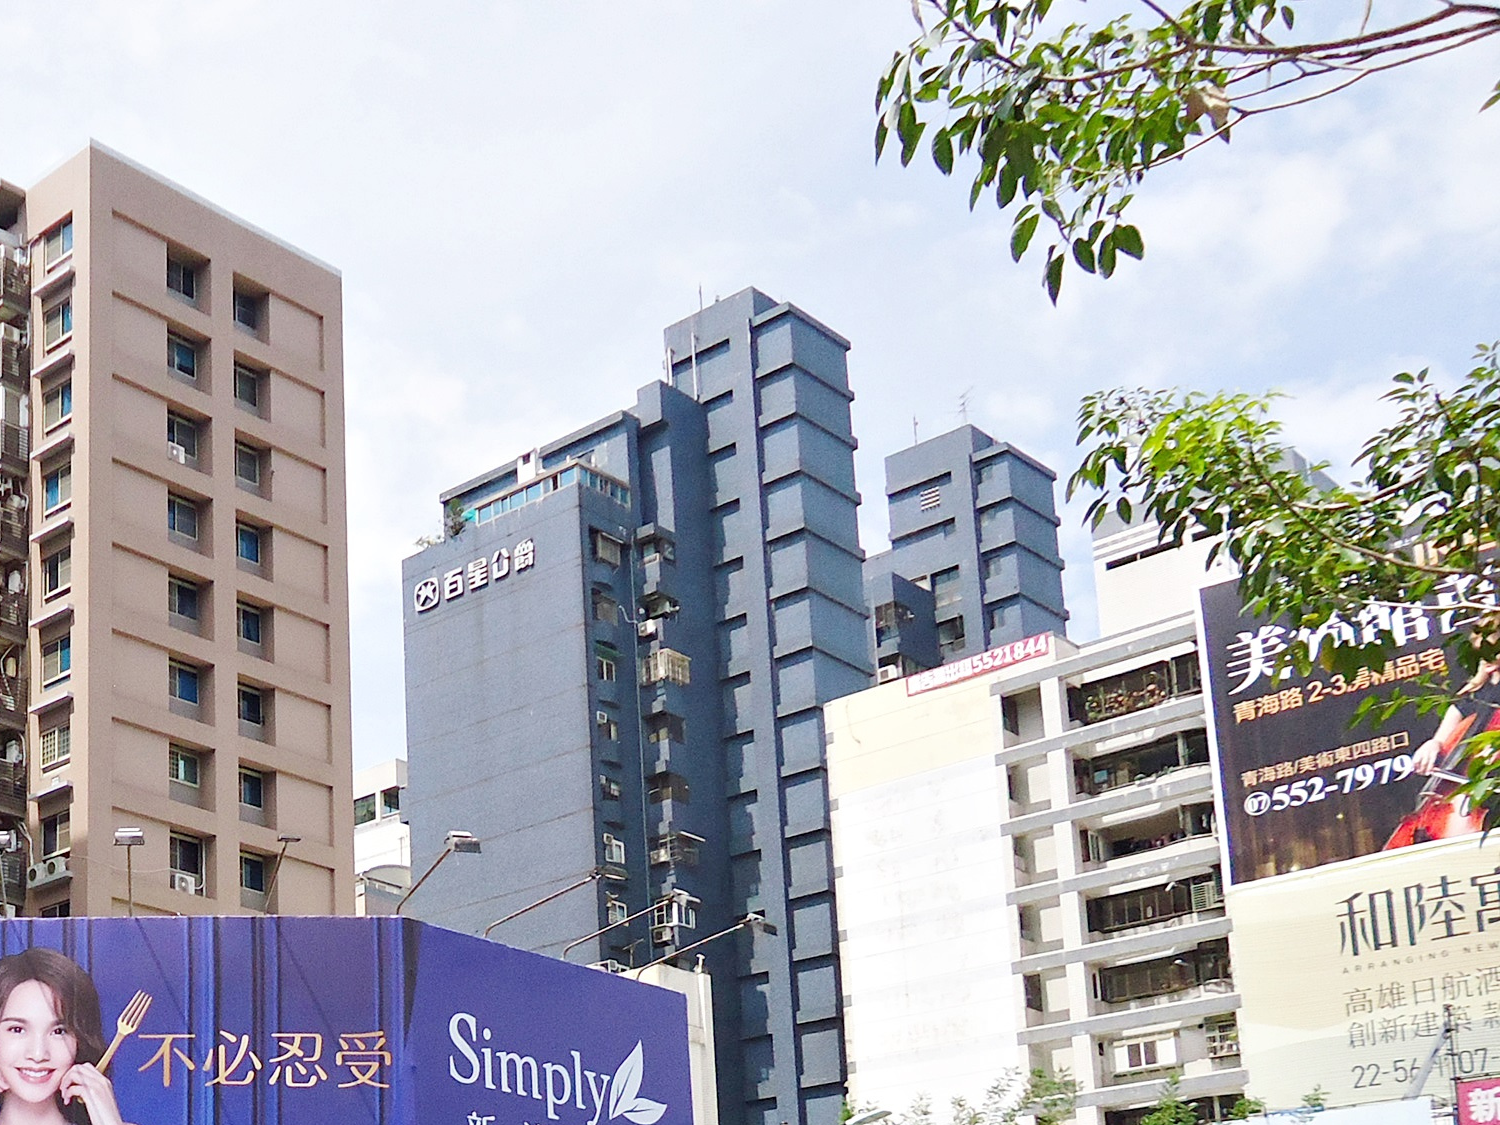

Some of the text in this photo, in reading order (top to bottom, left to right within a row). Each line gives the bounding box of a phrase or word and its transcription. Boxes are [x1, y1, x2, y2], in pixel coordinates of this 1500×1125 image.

[972, 635, 1048, 674] 5521844
[1233, 687, 1304, 724] 青海路
[1241, 731, 1410, 788] 青海路/美術東四路口
[1342, 950, 1450, 974] ARRANGING
[138, 1030, 392, 1089] 不必忍受
